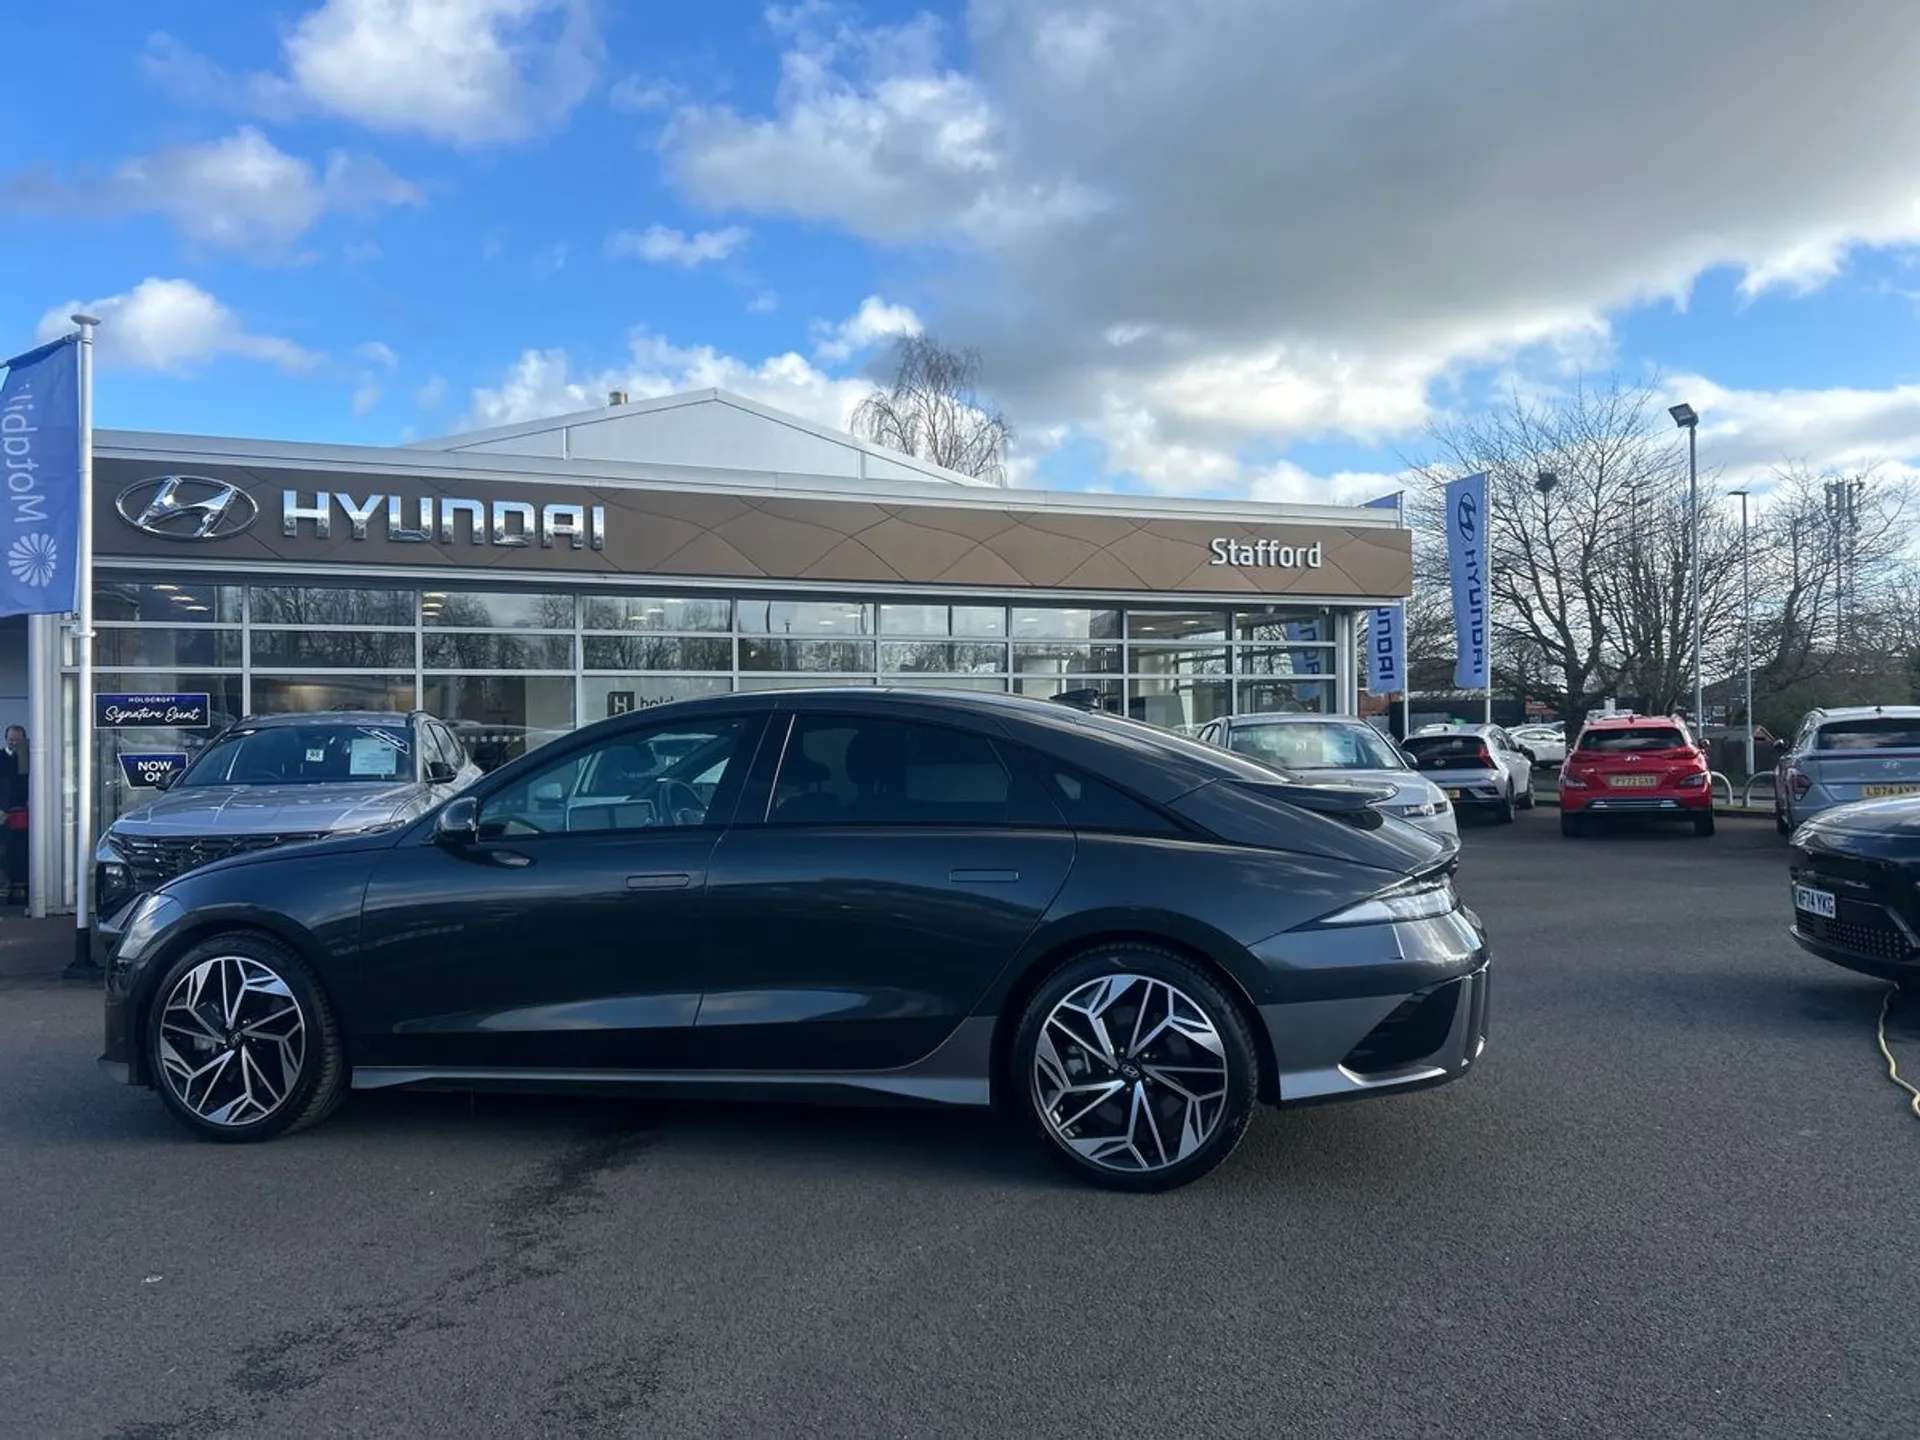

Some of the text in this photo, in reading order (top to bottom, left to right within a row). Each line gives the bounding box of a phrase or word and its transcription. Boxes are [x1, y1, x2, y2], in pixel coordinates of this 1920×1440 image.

[282, 488, 605, 551] HYUNDAI
[1210, 538, 1322, 568] Stafford
[1464, 549, 1483, 675] HYUNDAI
[105, 705, 200, 724] Signature Event
[137, 760, 172, 771] NOW
